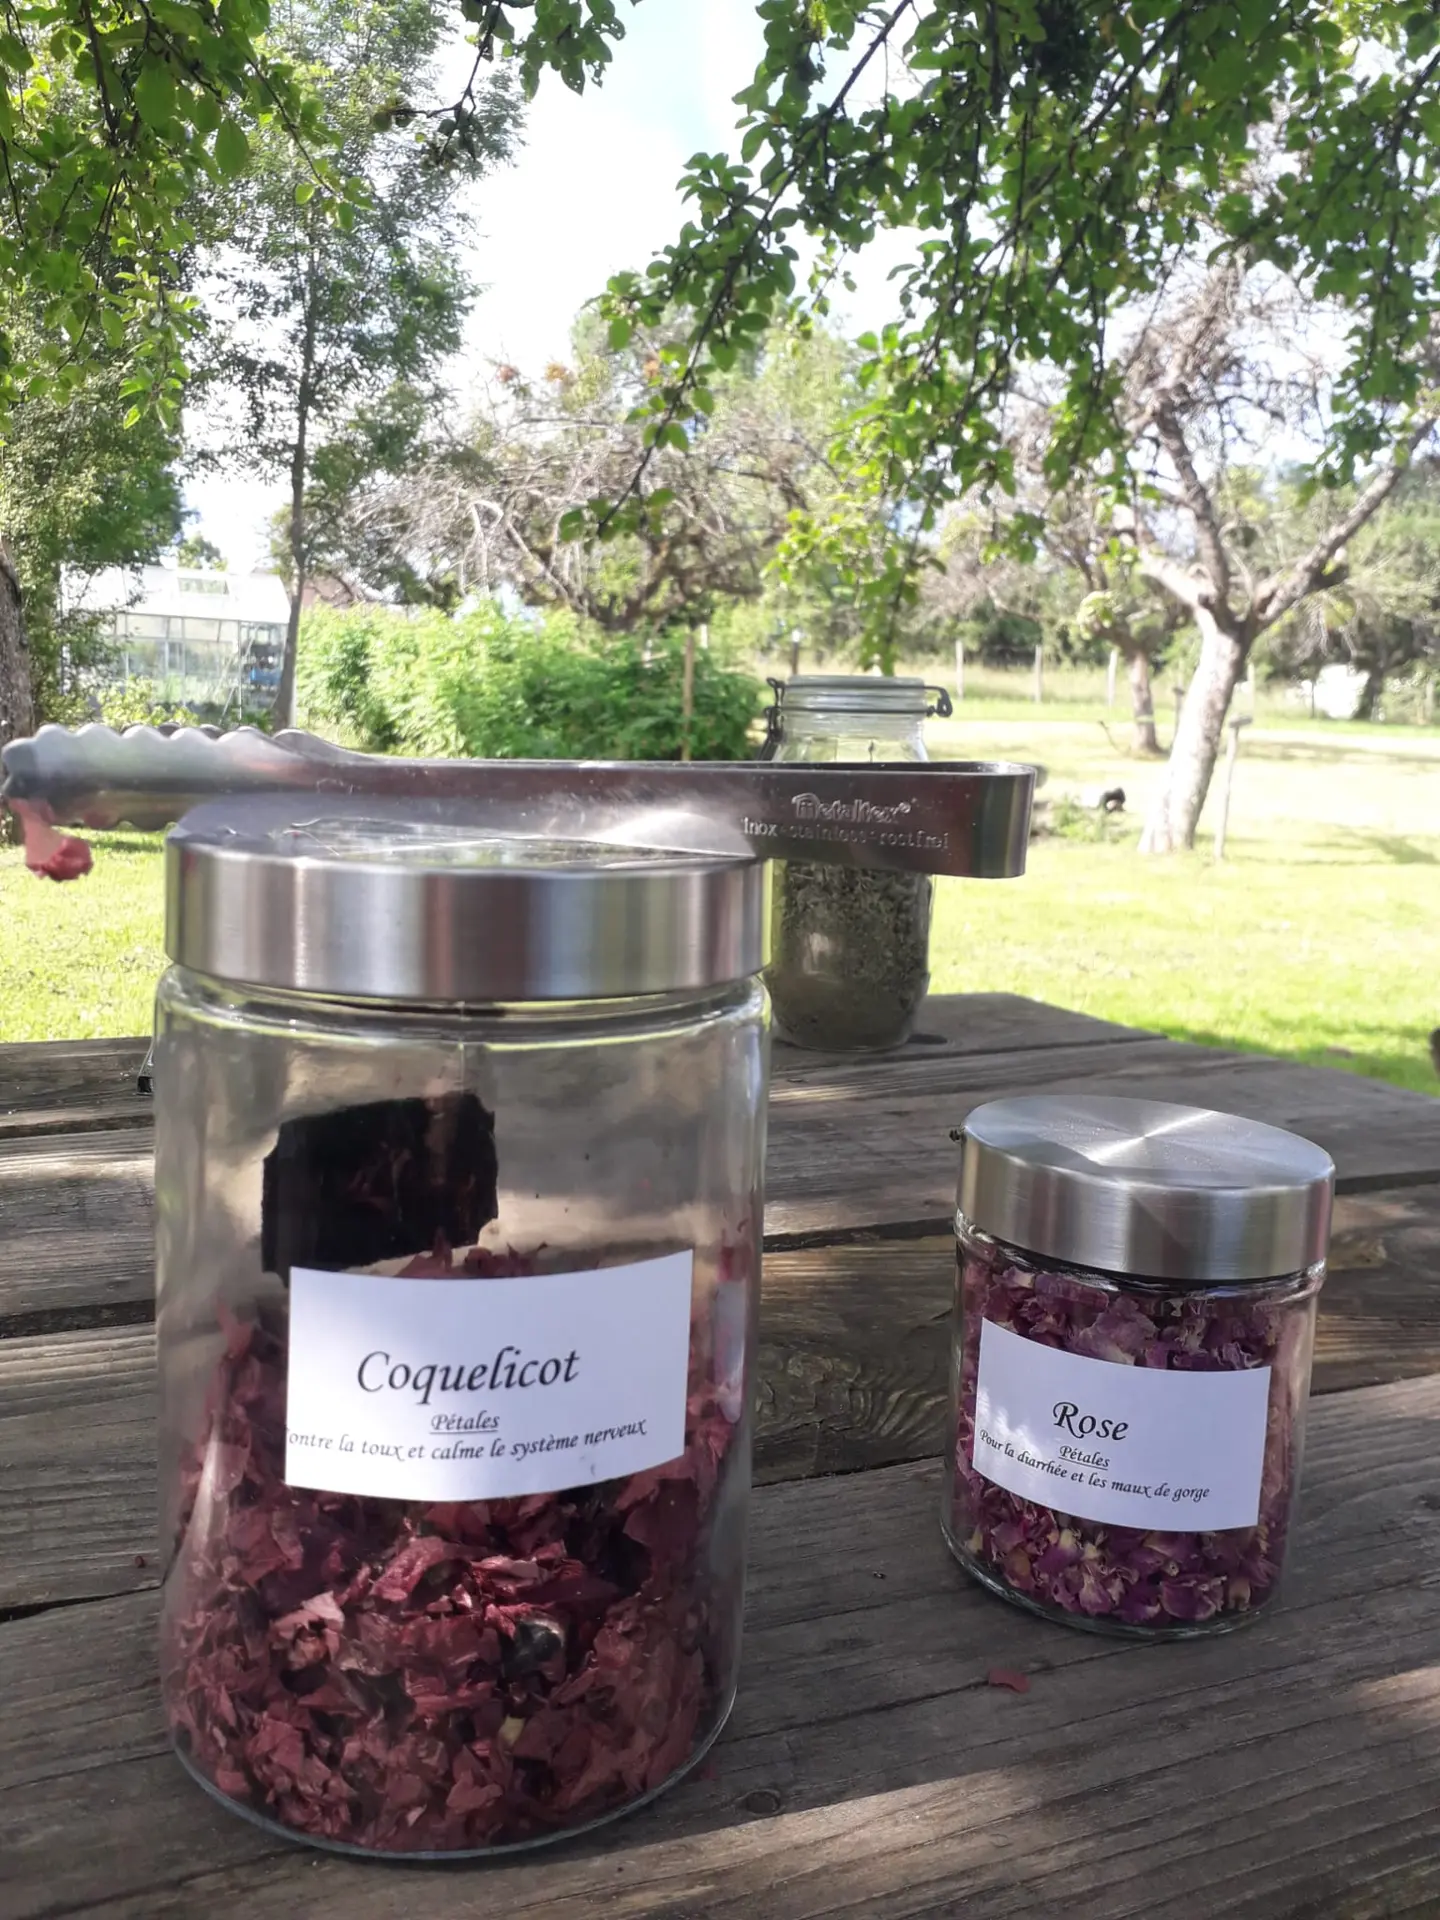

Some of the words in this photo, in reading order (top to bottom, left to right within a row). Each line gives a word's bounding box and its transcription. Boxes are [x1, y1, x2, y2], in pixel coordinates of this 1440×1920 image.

[357, 1346, 580, 1405] Coquelicot
[286, 1428, 333, 1450] ontre
[338, 1433, 354, 1453] la
[361, 1440, 405, 1460] toux
[408, 1444, 425, 1459] et
[431, 1439, 484, 1460] calme
[490, 1437, 505, 1458] le
[510, 1433, 578, 1460] système
[584, 1418, 648, 1446] nerveux
[430, 1411, 500, 1435] Pétales
[1052, 1401, 1129, 1441] Rose
[979, 1430, 1003, 1451] Pour
[1005, 1442, 1015, 1458] la
[1017, 1450, 1067, 1478] diarrhée
[1071, 1470, 1084, 1483] et
[1088, 1471, 1107, 1488] les
[1111, 1480, 1152, 1498] maux
[1154, 1482, 1170, 1498] de
[1172, 1487, 1210, 1502] gorge
[1058, 1445, 1110, 1470] Pétales
